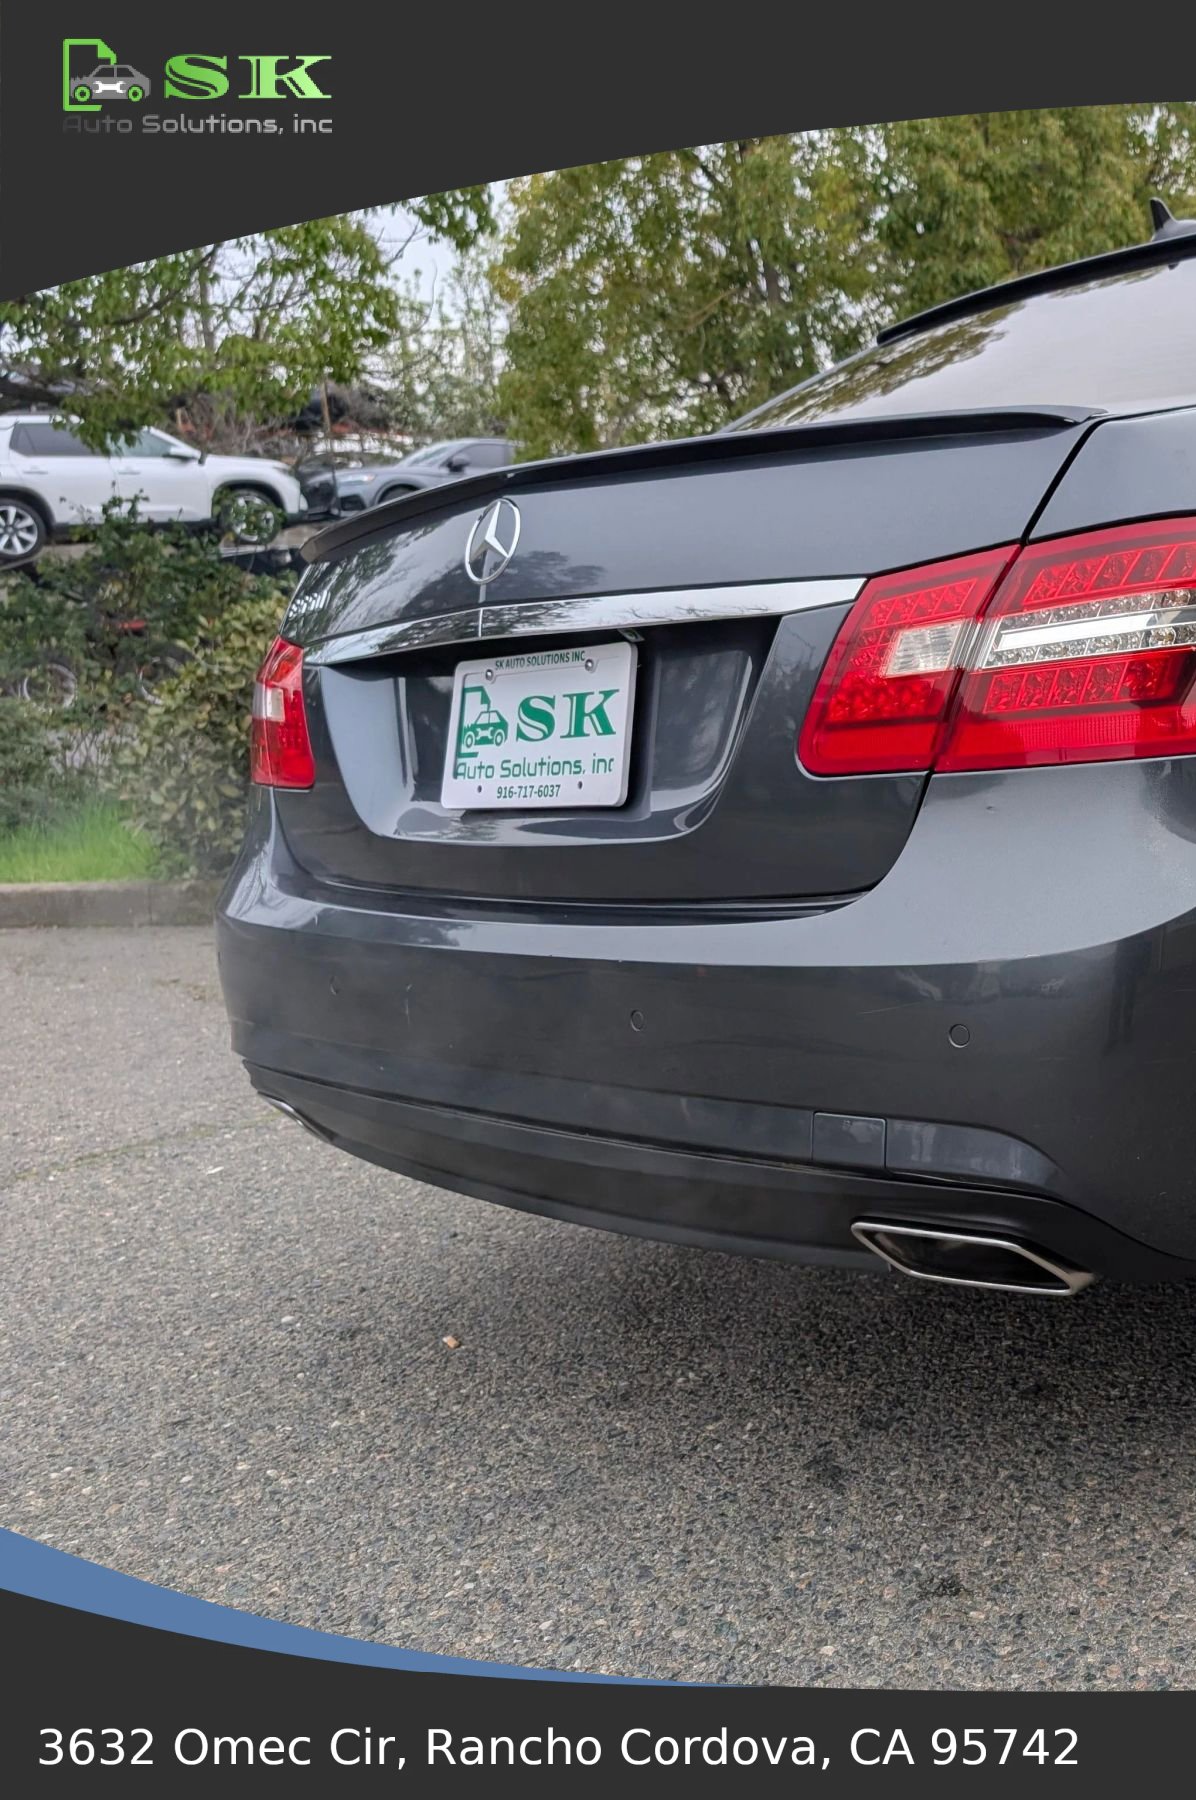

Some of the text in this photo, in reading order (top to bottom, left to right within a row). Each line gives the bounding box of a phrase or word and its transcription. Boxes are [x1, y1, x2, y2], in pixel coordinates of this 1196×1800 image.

[495, 650, 586, 670] SK AUTO SOLUTIONS INC
[517, 690, 619, 742] SK
[456, 761, 495, 780] Auto
[500, 755, 587, 778] Solutions,
[497, 785, 561, 799] 916-717-6037
